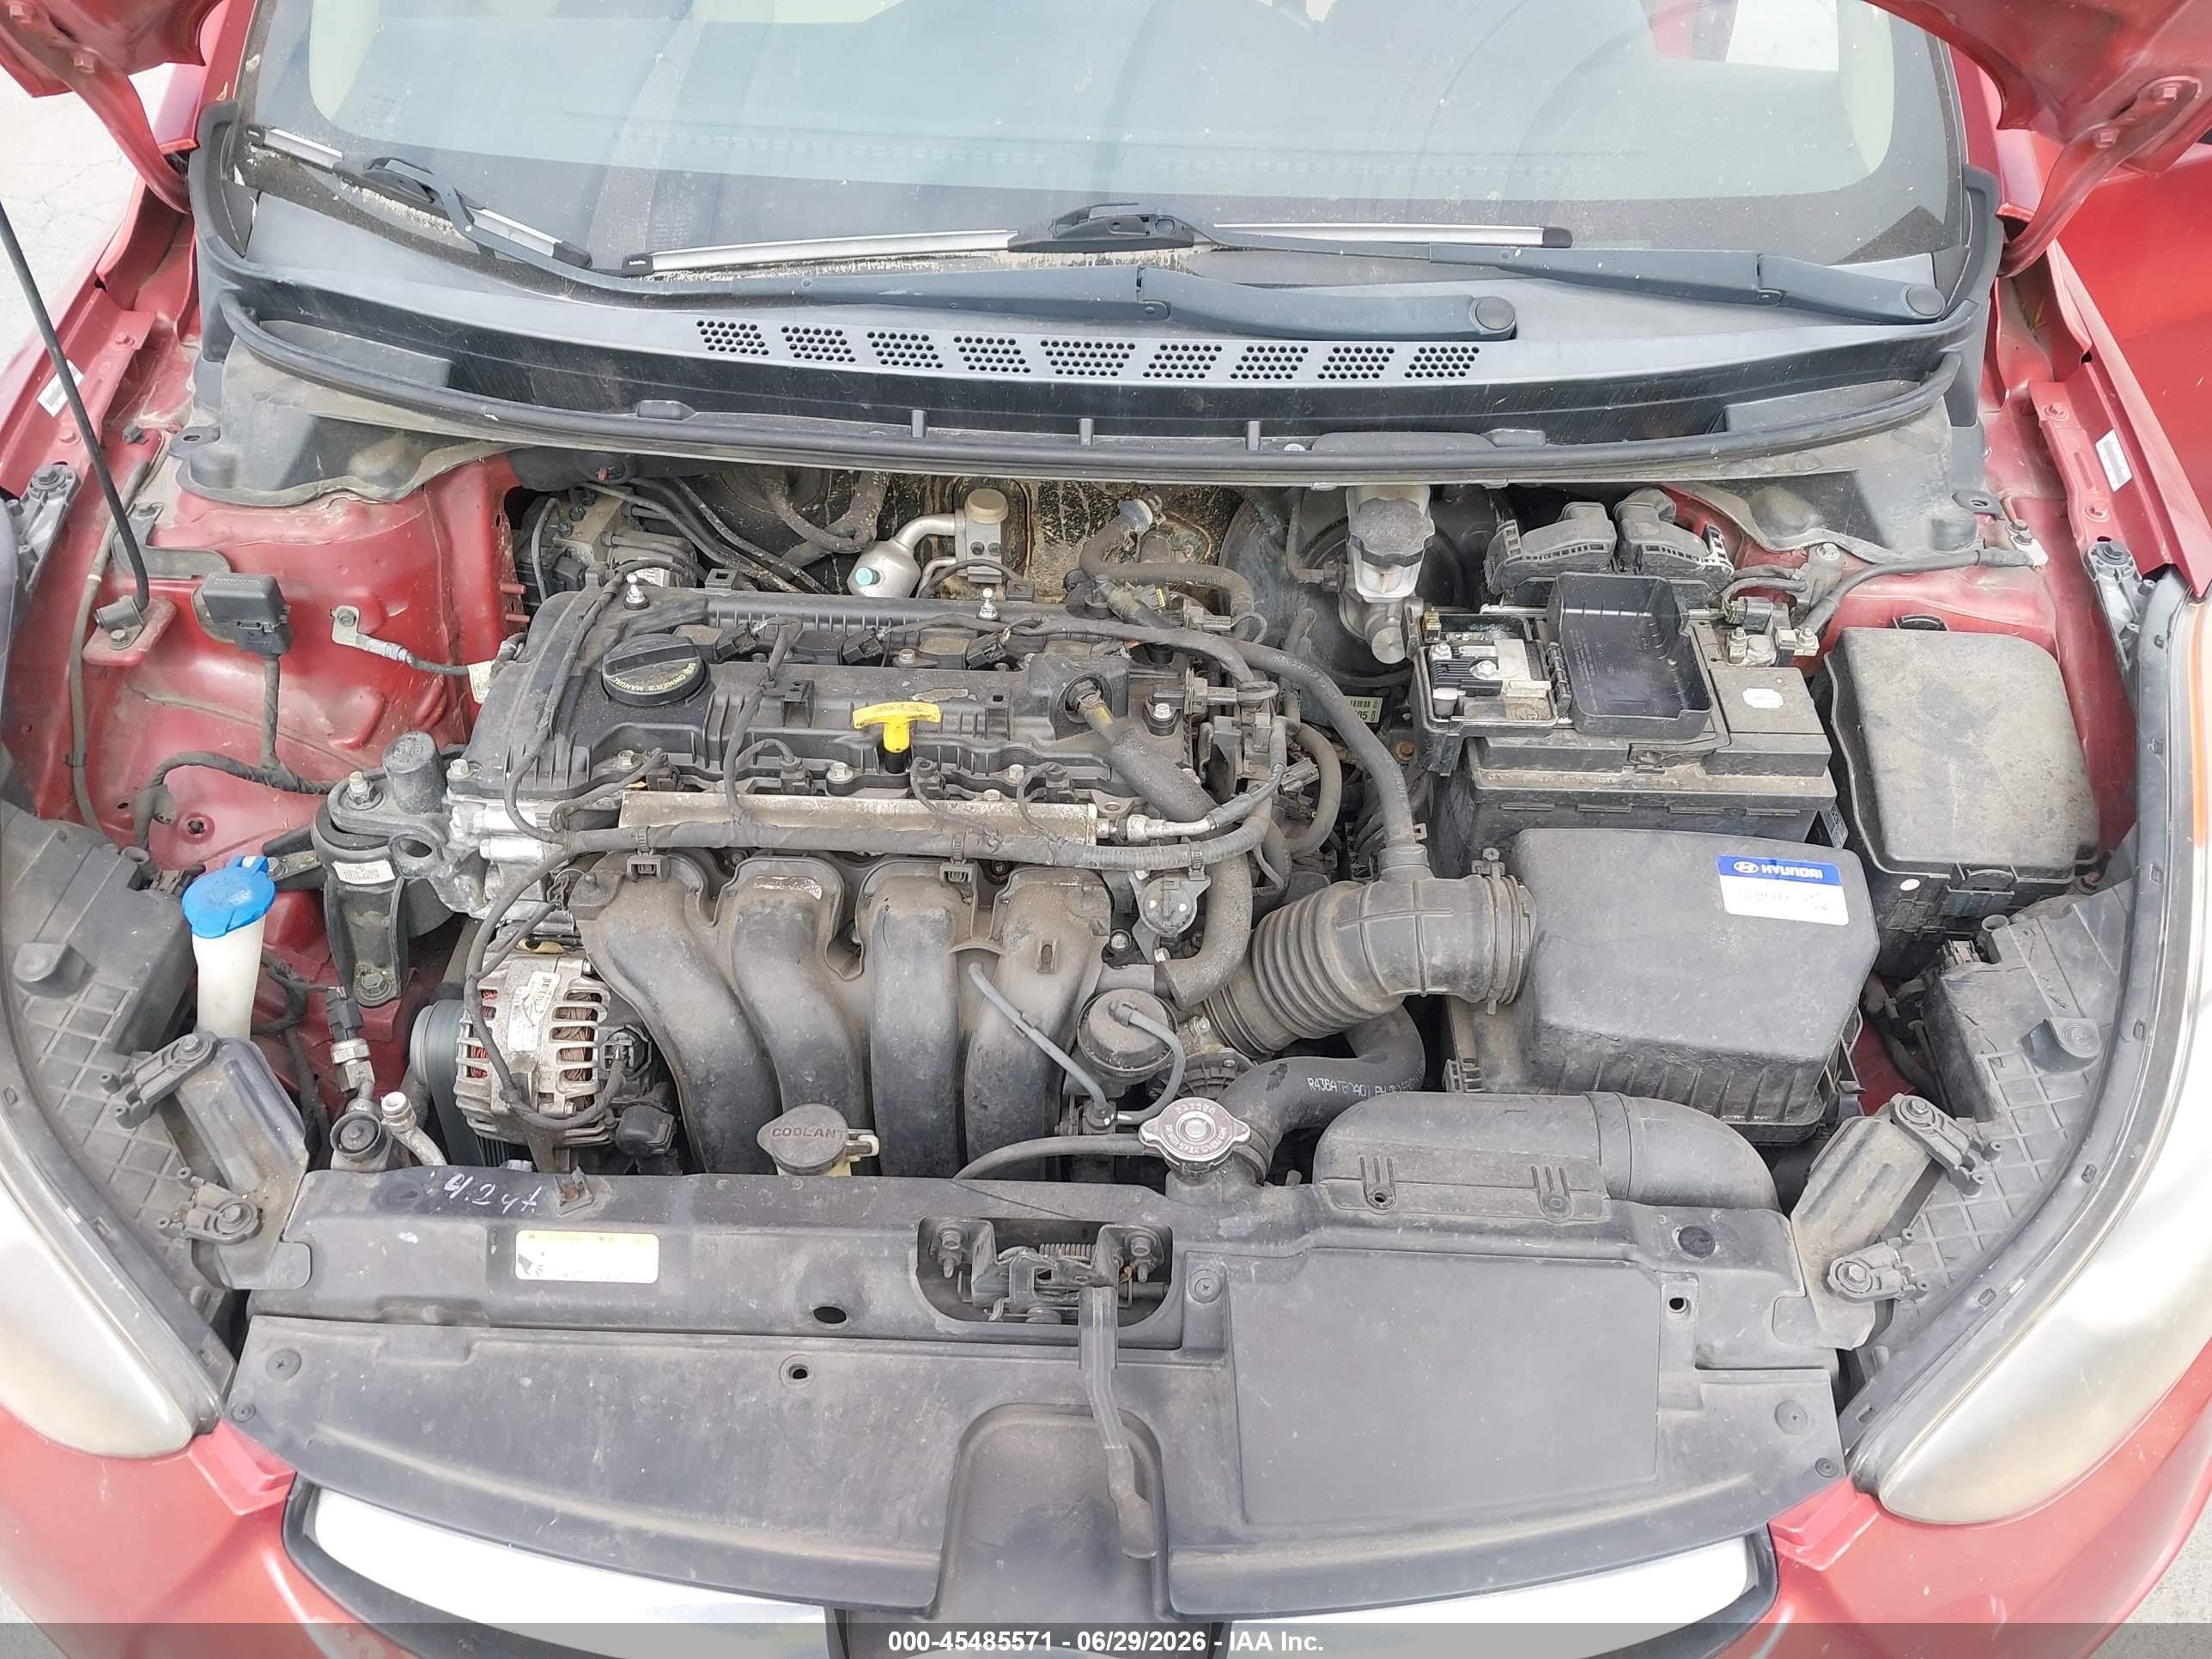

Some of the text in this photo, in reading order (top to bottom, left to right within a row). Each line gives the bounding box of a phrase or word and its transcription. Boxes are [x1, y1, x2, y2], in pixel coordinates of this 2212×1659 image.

[612, 677, 644, 692] MANUAL
[648, 674, 686, 691] OWNER'S
[1761, 864, 1824, 879] HYUNDAI
